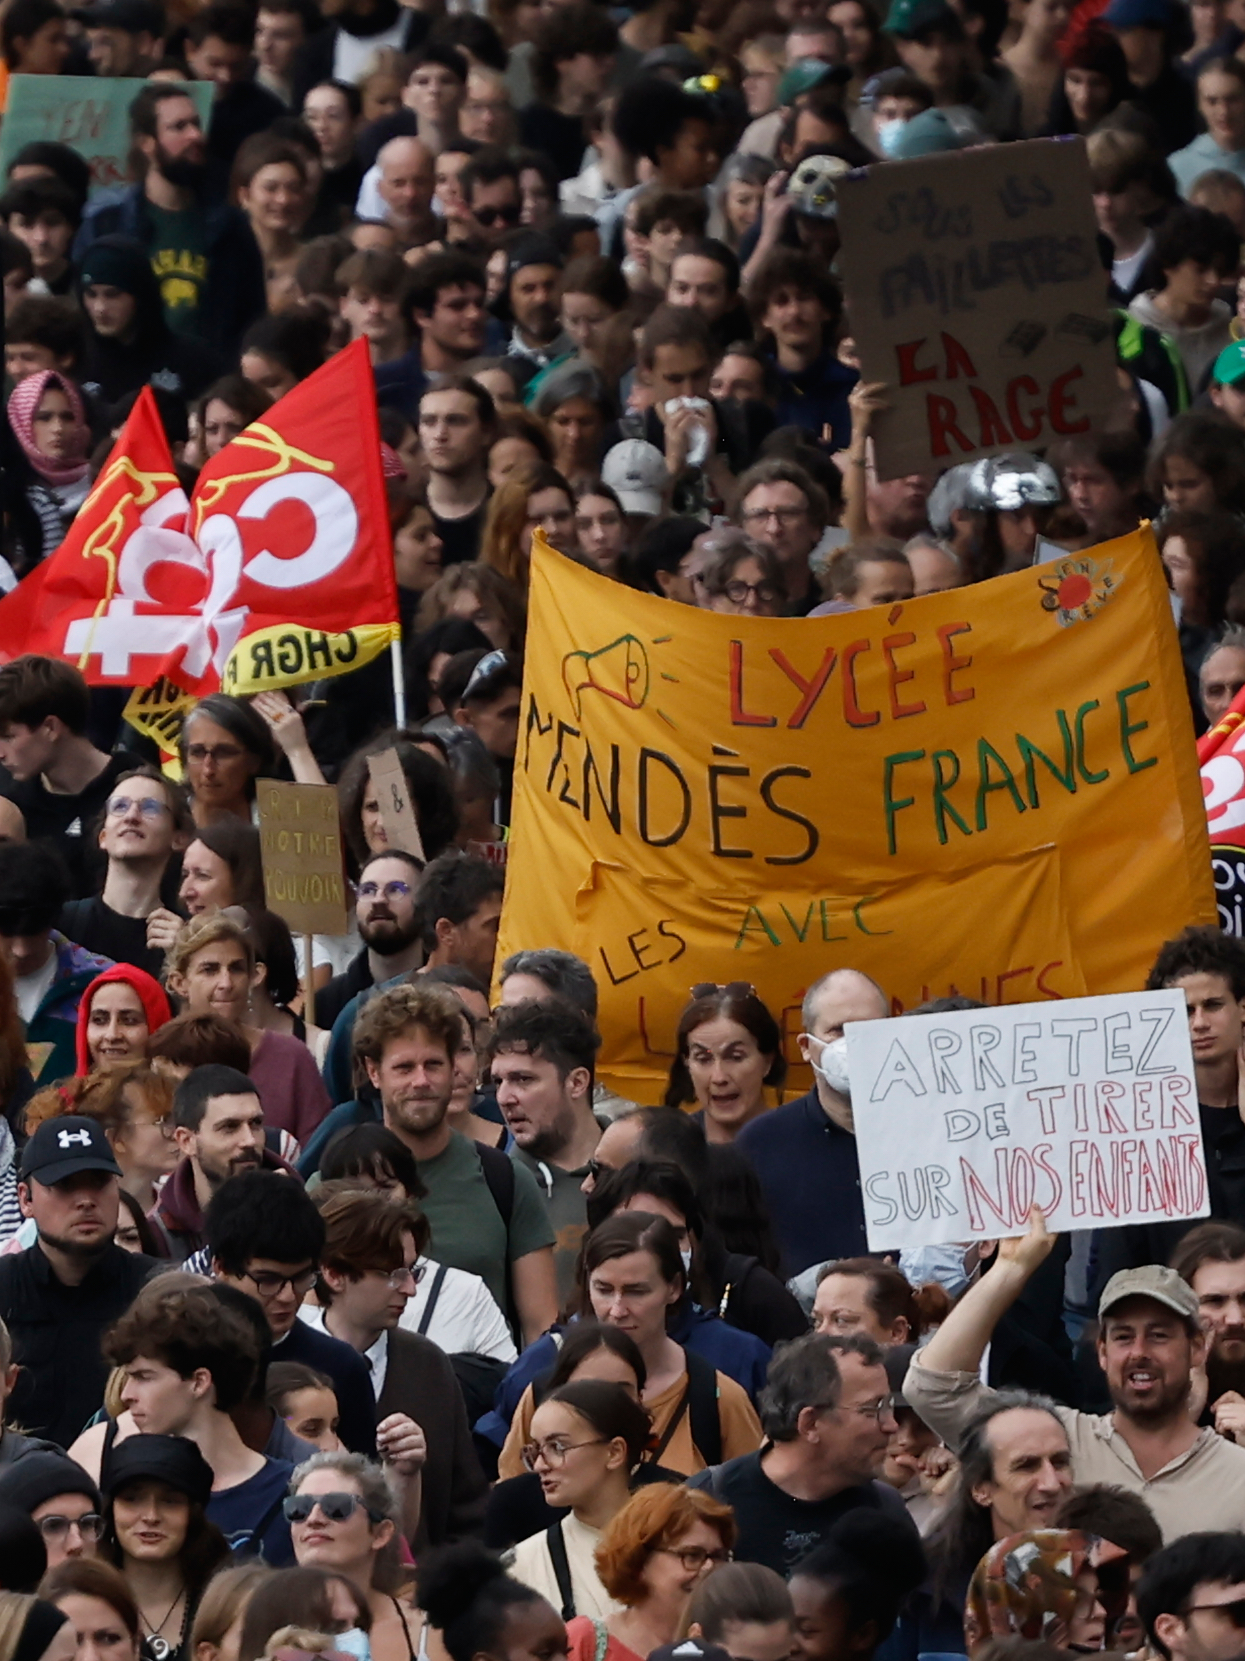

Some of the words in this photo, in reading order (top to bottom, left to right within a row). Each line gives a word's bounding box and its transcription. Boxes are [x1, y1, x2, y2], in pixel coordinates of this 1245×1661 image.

[873, 185, 973, 240] SOUS
[997, 173, 1055, 219] LES
[895, 330, 978, 388] LA
[925, 364, 1092, 458] RAGE
[728, 604, 975, 729] LYCÉE
[524, 692, 820, 866] MENDÈS
[884, 680, 1159, 856] FRANCE
[262, 829, 336, 856] NOTRE
[598, 918, 687, 986] LES
[733, 896, 895, 949] AVEC
[869, 1008, 1177, 1102] ARRETEZ
[943, 1102, 1010, 1142] DE
[1026, 1075, 1195, 1135] TIRER
[865, 1163, 959, 1226] SUR
[959, 1143, 1063, 1231] NOS
[1069, 1133, 1204, 1218] ENFANTS
